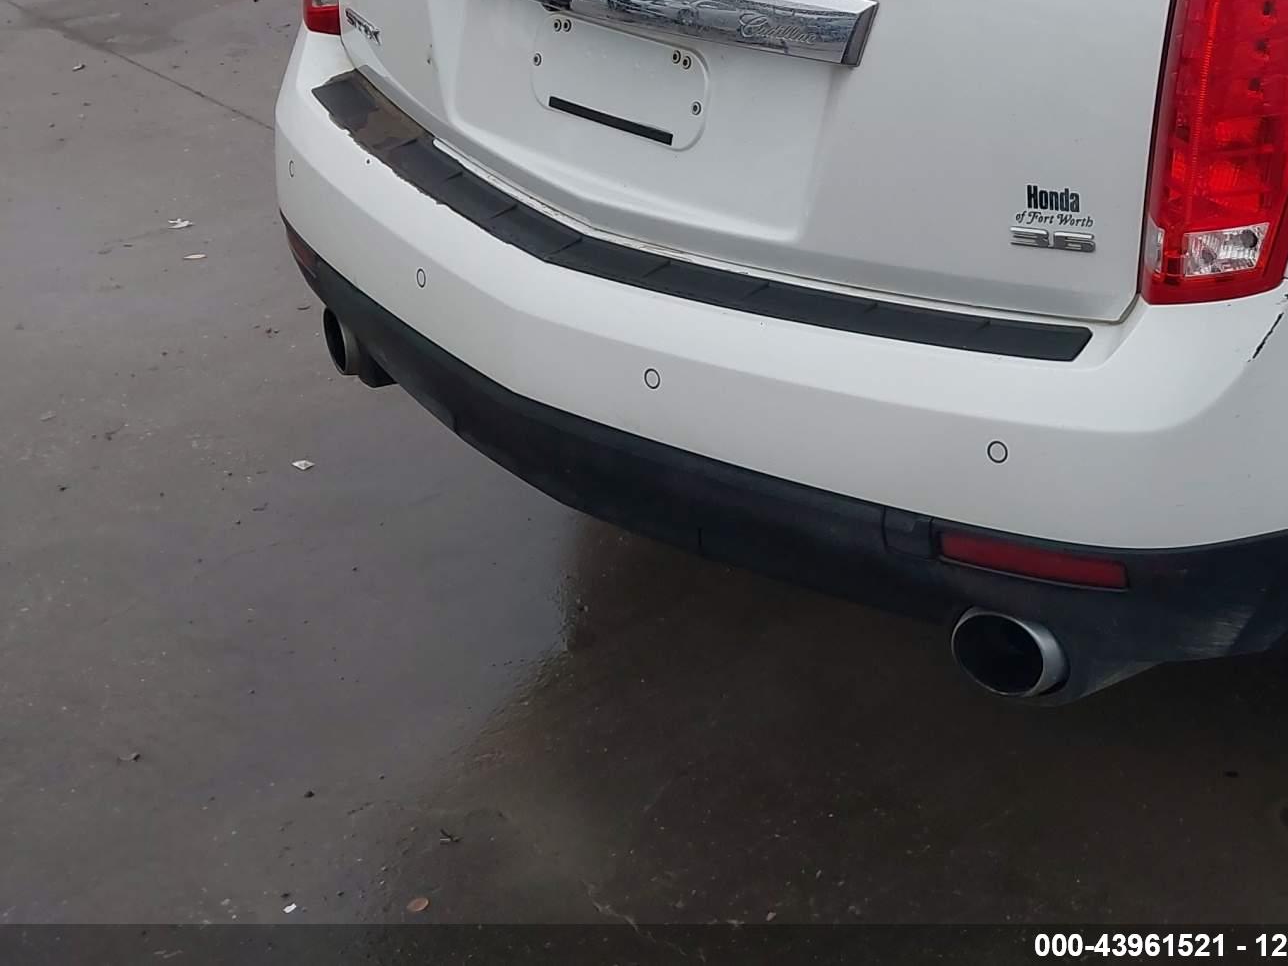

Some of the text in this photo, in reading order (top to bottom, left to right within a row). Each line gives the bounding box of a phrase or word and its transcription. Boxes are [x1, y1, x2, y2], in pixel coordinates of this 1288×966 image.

[739, 11, 817, 45] Cadillac
[1026, 184, 1080, 213] Honda
[1015, 210, 1094, 228] of Fort Worth
